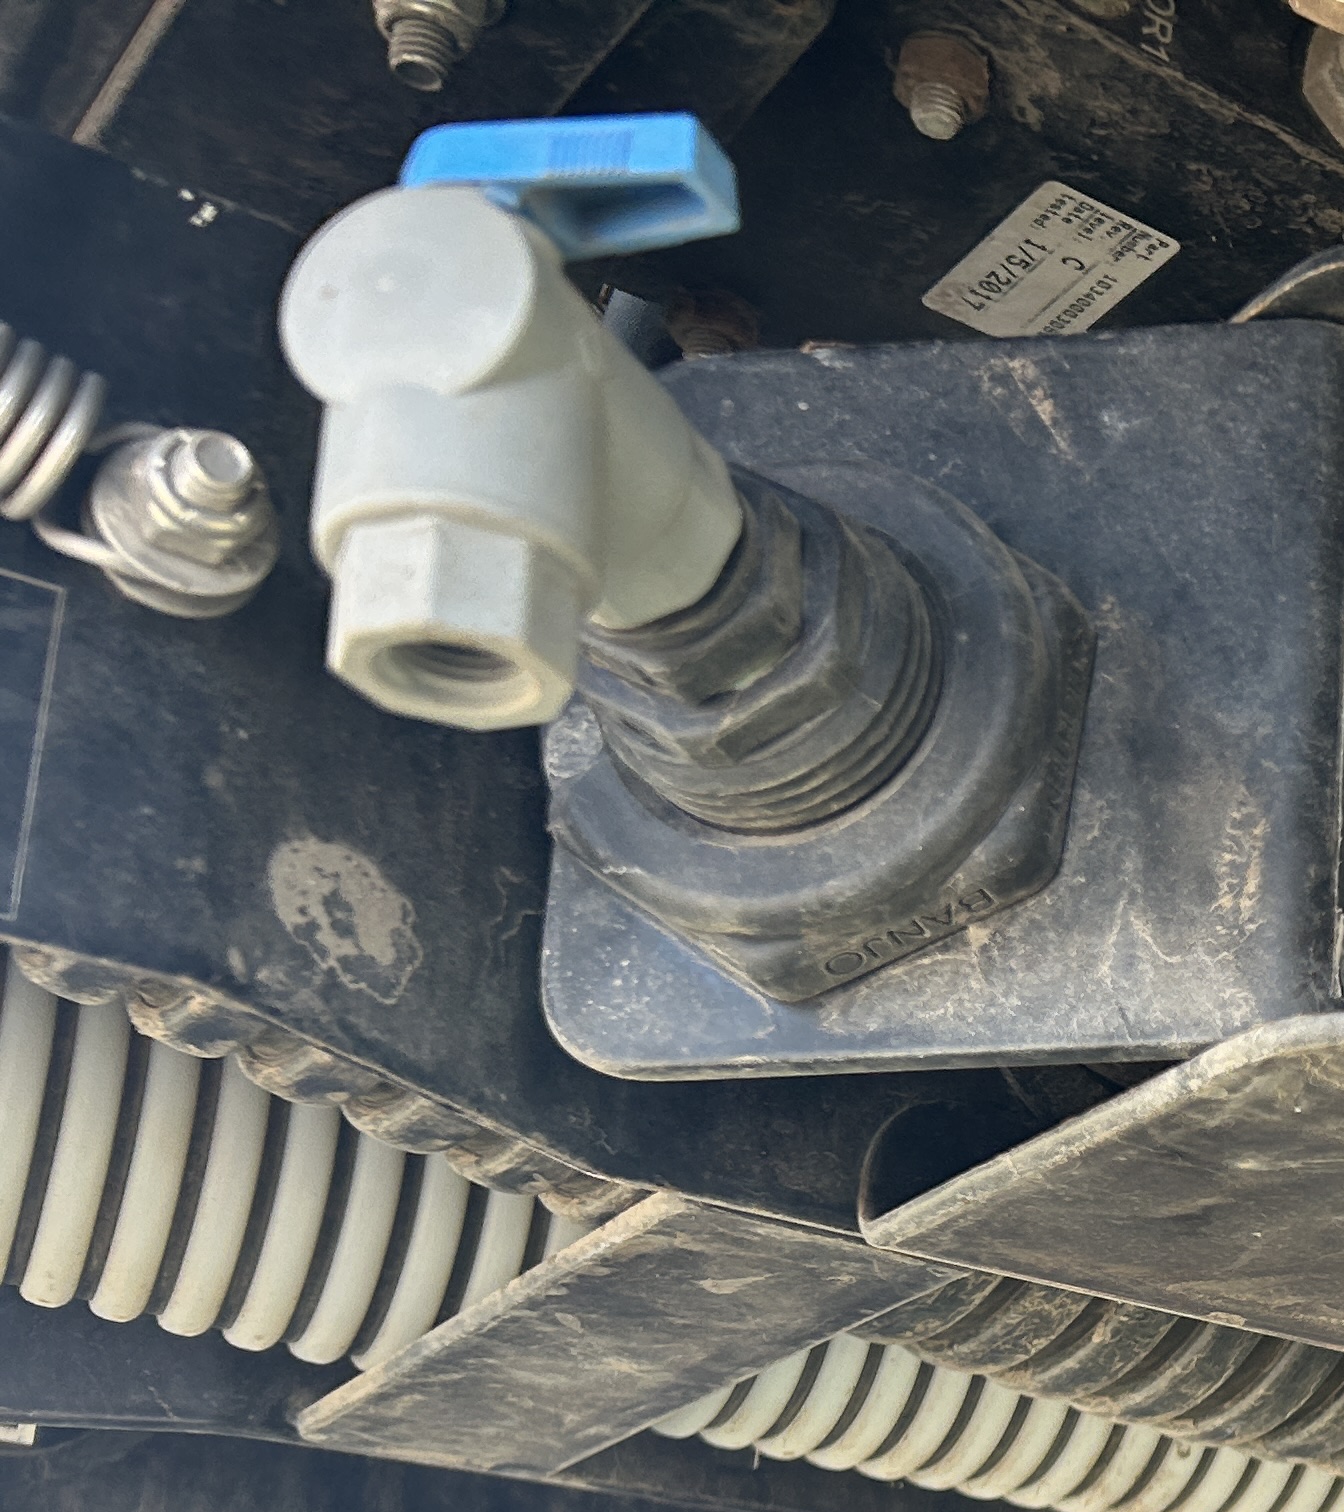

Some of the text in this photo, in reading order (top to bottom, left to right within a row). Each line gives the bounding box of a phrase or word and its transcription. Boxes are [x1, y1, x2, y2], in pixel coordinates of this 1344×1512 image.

[1061, 201, 1095, 225] Date
[1136, 237, 1170, 261] Part
[961, 238, 1048, 312] 1/5/2017
[1061, 256, 1085, 271] C
[825, 888, 997, 976] BANJO
